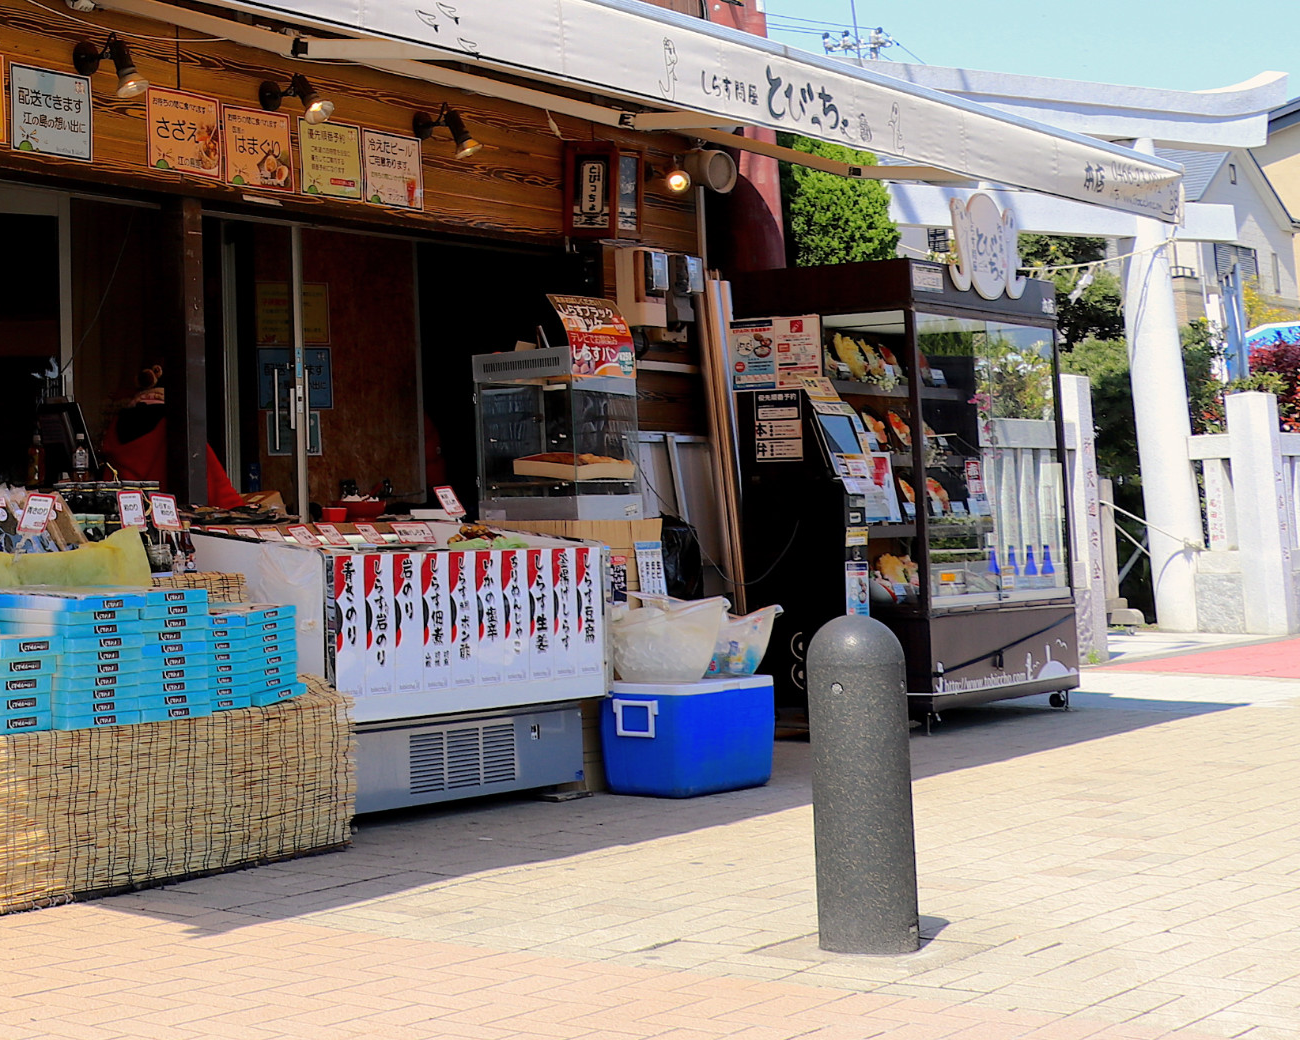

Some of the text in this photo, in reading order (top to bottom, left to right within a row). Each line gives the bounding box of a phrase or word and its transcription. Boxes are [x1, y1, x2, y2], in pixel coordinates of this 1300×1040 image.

[18, 87, 83, 113] 配送できます
[702, 70, 759, 106] しらす問屋
[766, 65, 854, 141] とびっちょ
[23, 112, 86, 134] 江の島の想い出に
[156, 117, 199, 144] さざえ
[235, 135, 280, 158] はまぐり
[368, 138, 413, 157] 冷えたビール
[588, 165, 601, 212] とびっちょ
[558, 304, 613, 318] しらすブラック
[573, 344, 619, 362] しらすパン
[402, 558, 413, 620] 岩のり
[430, 558, 444, 644] しらす佃煮
[483, 558, 498, 642] いかの塩辛
